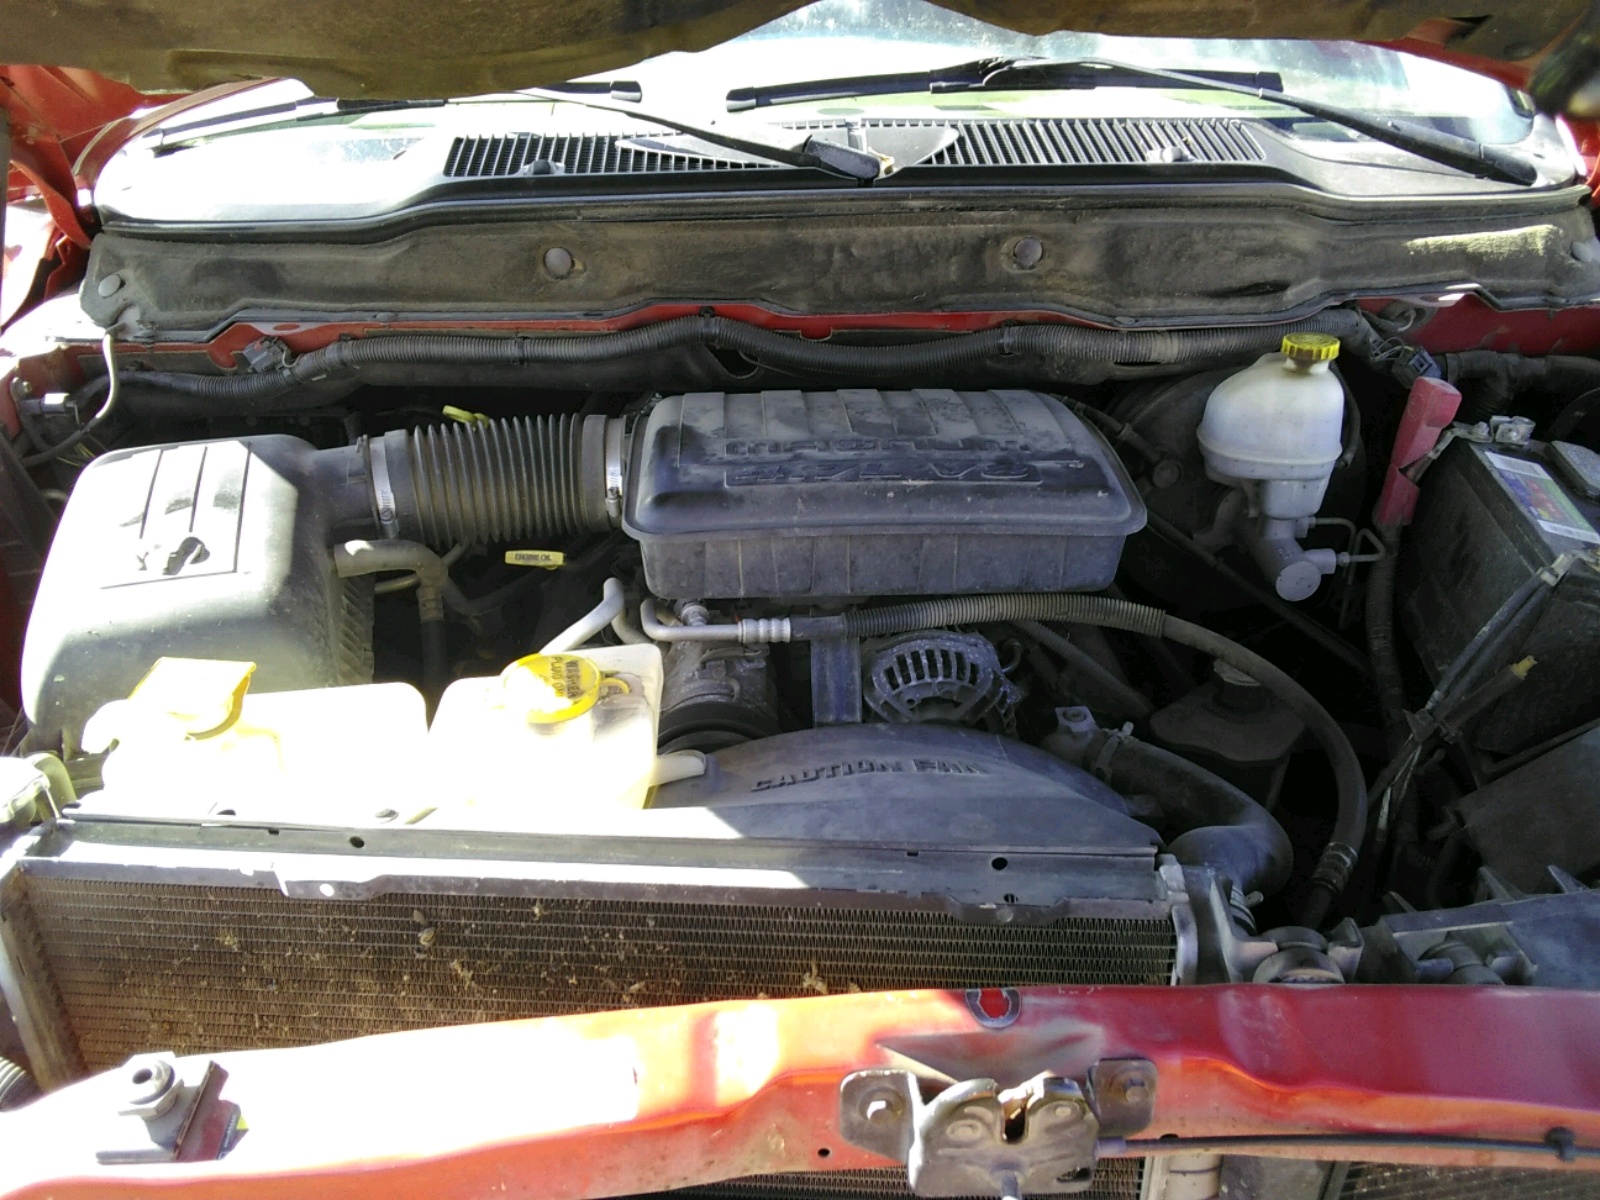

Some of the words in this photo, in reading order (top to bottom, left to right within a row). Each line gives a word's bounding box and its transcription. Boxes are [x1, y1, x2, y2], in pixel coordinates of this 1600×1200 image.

[930, 462, 1029, 480] V8
[515, 553, 539, 562] ENGINE
[541, 554, 552, 562] OIL
[551, 656, 563, 679] FLUID
[565, 660, 580, 699] WASHER
[751, 758, 903, 793] CAUTION
[913, 758, 992, 775] FAN
